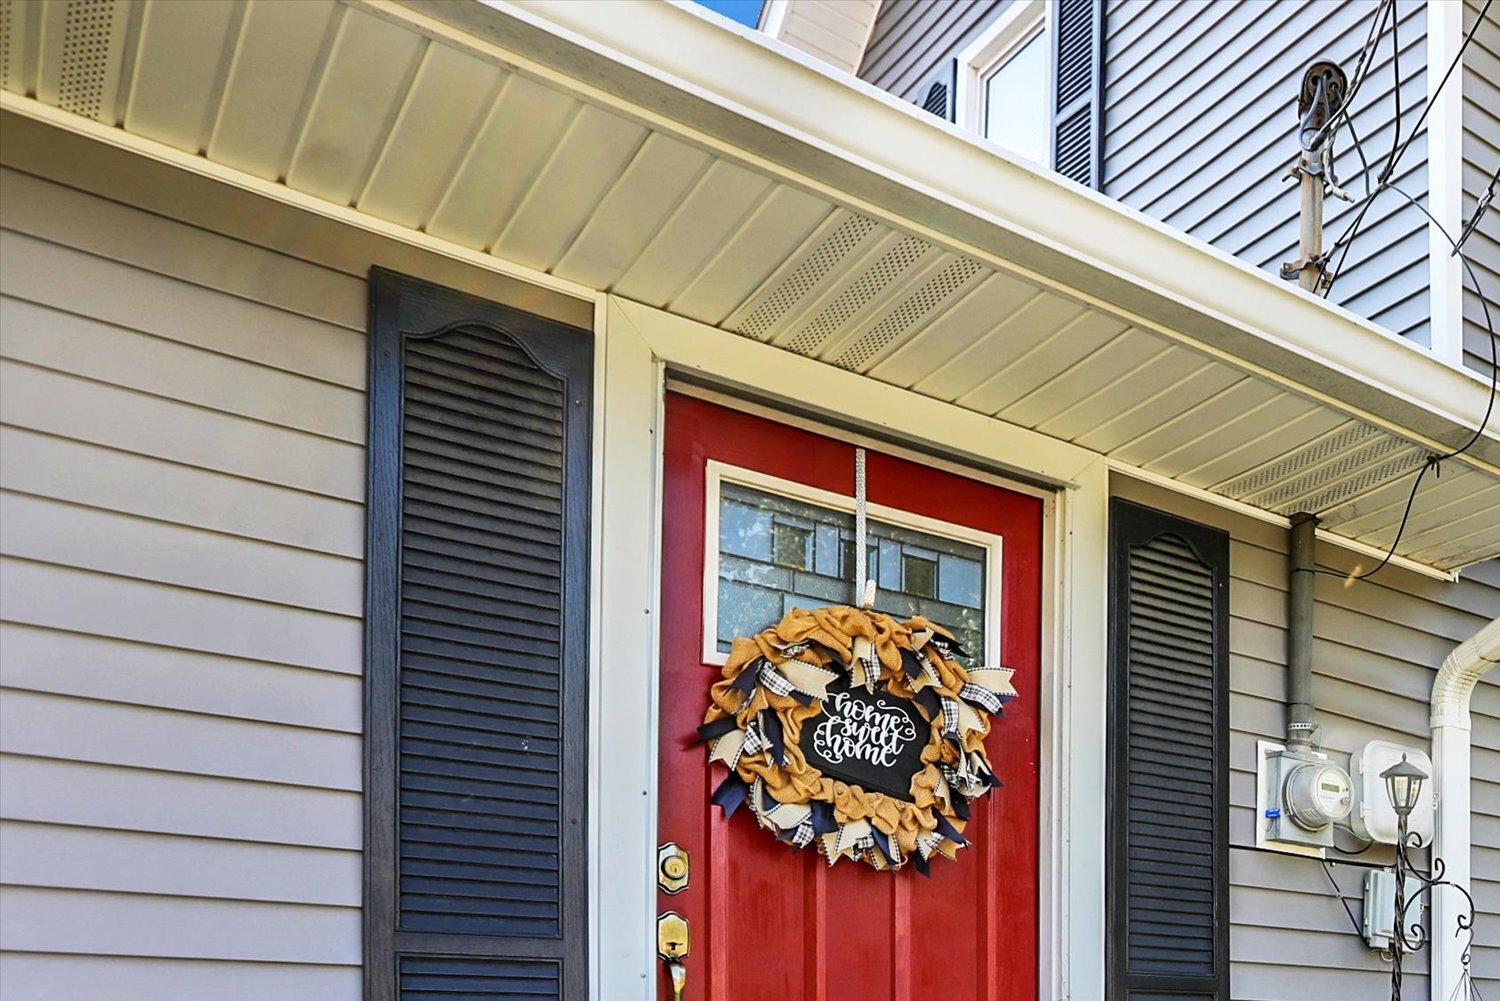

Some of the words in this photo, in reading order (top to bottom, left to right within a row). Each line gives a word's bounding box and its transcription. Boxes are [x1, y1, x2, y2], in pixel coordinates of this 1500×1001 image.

[834, 692, 904, 731] home
[824, 715, 897, 767] home
[841, 718, 904, 755] sweet
